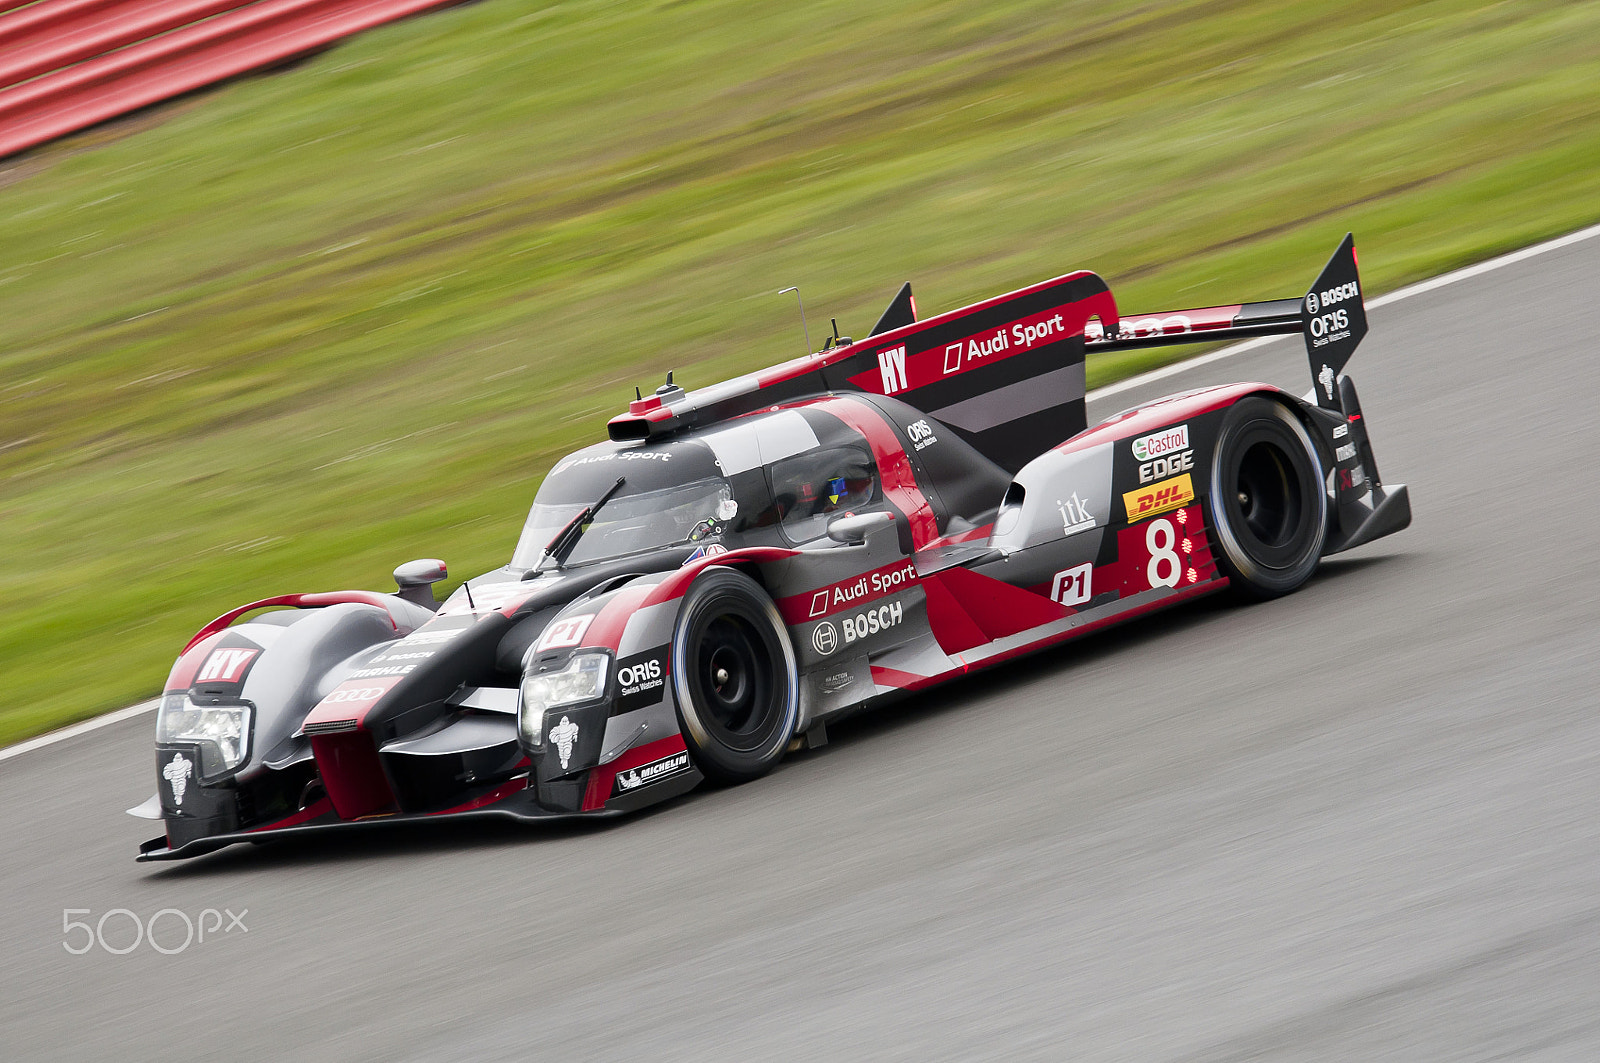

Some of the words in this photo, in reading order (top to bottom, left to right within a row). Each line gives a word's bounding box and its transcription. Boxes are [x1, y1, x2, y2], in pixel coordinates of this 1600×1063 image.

[1320, 281, 1359, 307] BOSCH
[967, 329, 1009, 361] Audi
[1012, 314, 1065, 347] Sport
[1310, 309, 1349, 338] ORIS
[877, 346, 908, 395] HY
[907, 419, 932, 442] ORIS
[1147, 432, 1186, 456] Castrol
[573, 453, 617, 466] Audi
[618, 451, 672, 462] Sport
[1139, 450, 1195, 484] EDGE
[1056, 491, 1094, 528] itk
[1136, 485, 1184, 513] DHL
[1145, 518, 1182, 589] 8
[834, 578, 868, 605] Audi
[871, 564, 916, 593] Sport
[1057, 571, 1086, 602] P1
[546, 620, 583, 644] P1
[842, 601, 902, 643] BOSCH
[198, 649, 256, 681] HY
[351, 664, 418, 678] MAHLE
[617, 659, 660, 687] ORIS
[621, 684, 640, 696] Swiss
[640, 678, 663, 692] Watches
[641, 754, 687, 778] MICHELIN
